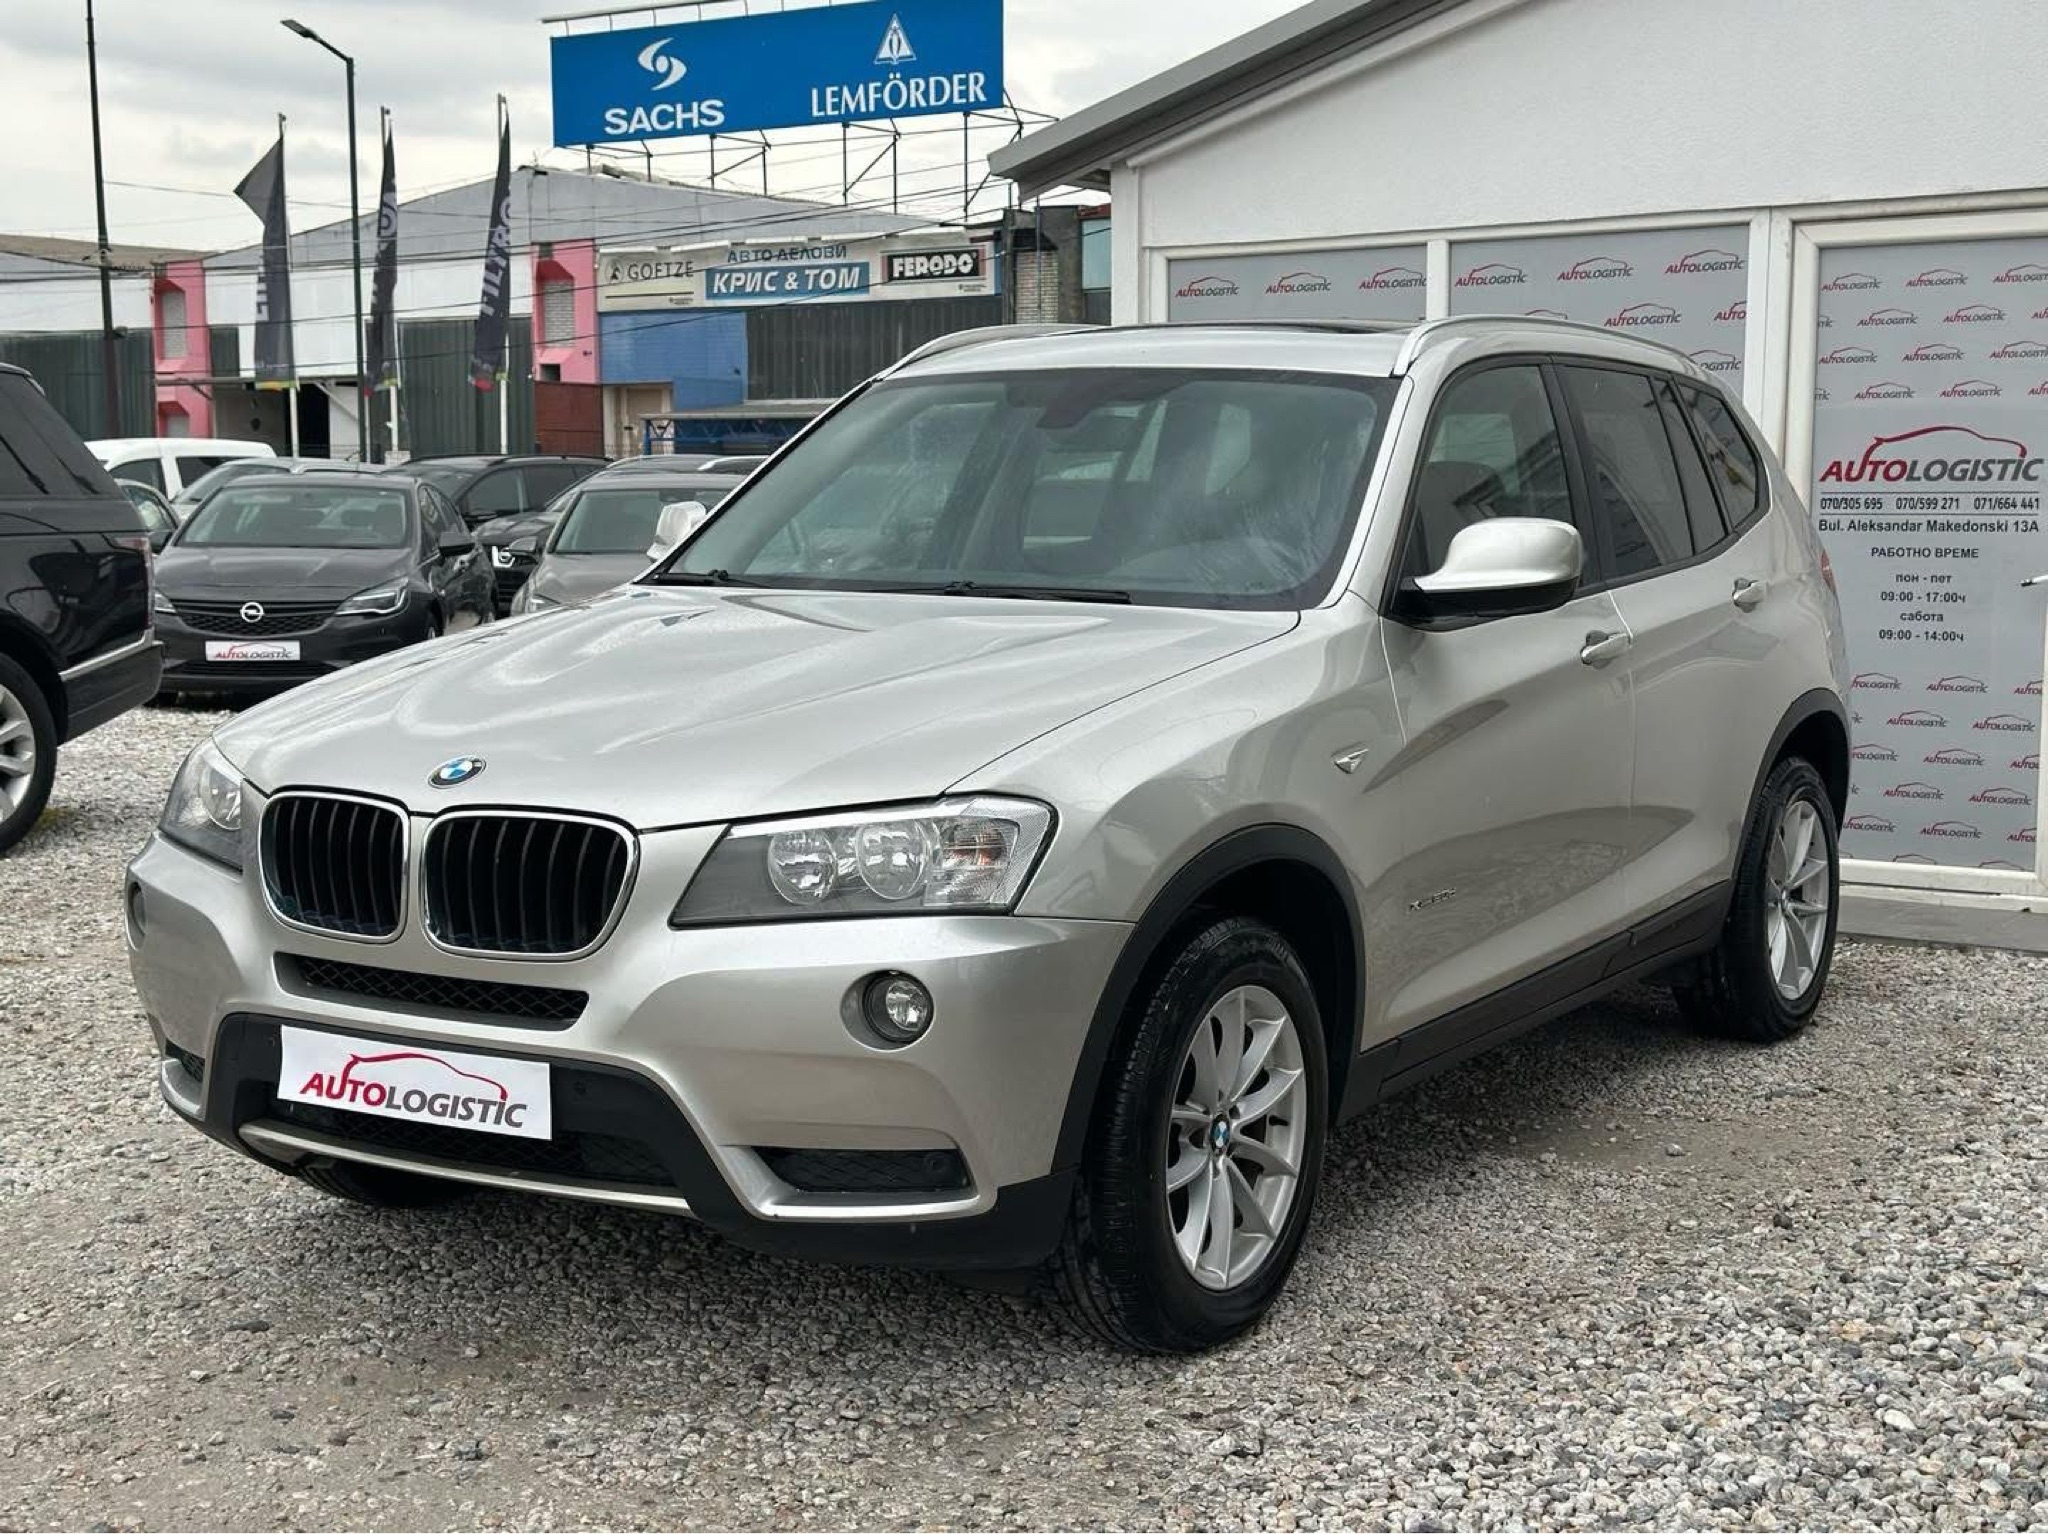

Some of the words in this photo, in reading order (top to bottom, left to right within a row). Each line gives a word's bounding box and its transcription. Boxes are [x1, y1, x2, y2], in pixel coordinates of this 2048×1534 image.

[811, 72, 986, 118] LEMFÖRDER
[604, 99, 725, 135] SACHS
[728, 248, 772, 263] АВТО
[893, 253, 974, 278] FERODO
[1665, 259, 1745, 274] AUTOLOGISTIC
[713, 271, 778, 294] КРИС
[784, 271, 799, 291] &
[805, 267, 860, 291] ТОМ
[1454, 273, 1526, 287] AUTOLOGISTIC
[1557, 266, 1634, 281] AUTOLOGISTIC
[1175, 285, 1239, 298] AUTOLOGISTIC
[1264, 281, 1331, 294] AUTOLOGISTIC
[1604, 312, 1681, 328] AUTOLOGISTIC
[1819, 457, 2044, 483] AUTOLOGISTIC
[1820, 497, 1860, 511] 070/305
[1864, 498, 1882, 510] 695
[1896, 497, 1938, 511] 070/599
[1941, 498, 1959, 510] 271
[1974, 497, 2017, 511] 071/664
[2020, 498, 2040, 510] 441
[1819, 519, 1844, 532] Bul.
[1847, 519, 1923, 532] Aleksandar
[1926, 519, 2008, 532] Makedonski
[2013, 520, 2039, 533] 13A
[1871, 547, 1931, 558] РАБОТНО
[1935, 548, 1979, 558] ВРЕМЕ
[1895, 574, 1919, 583] пон
[1930, 574, 1953, 583] пет
[1880, 591, 1914, 601] 09:00
[1900, 610, 1944, 622] сабота
[1879, 629, 1912, 640] 09:00
[299, 1072, 528, 1129] AUTOLOGISTIC
